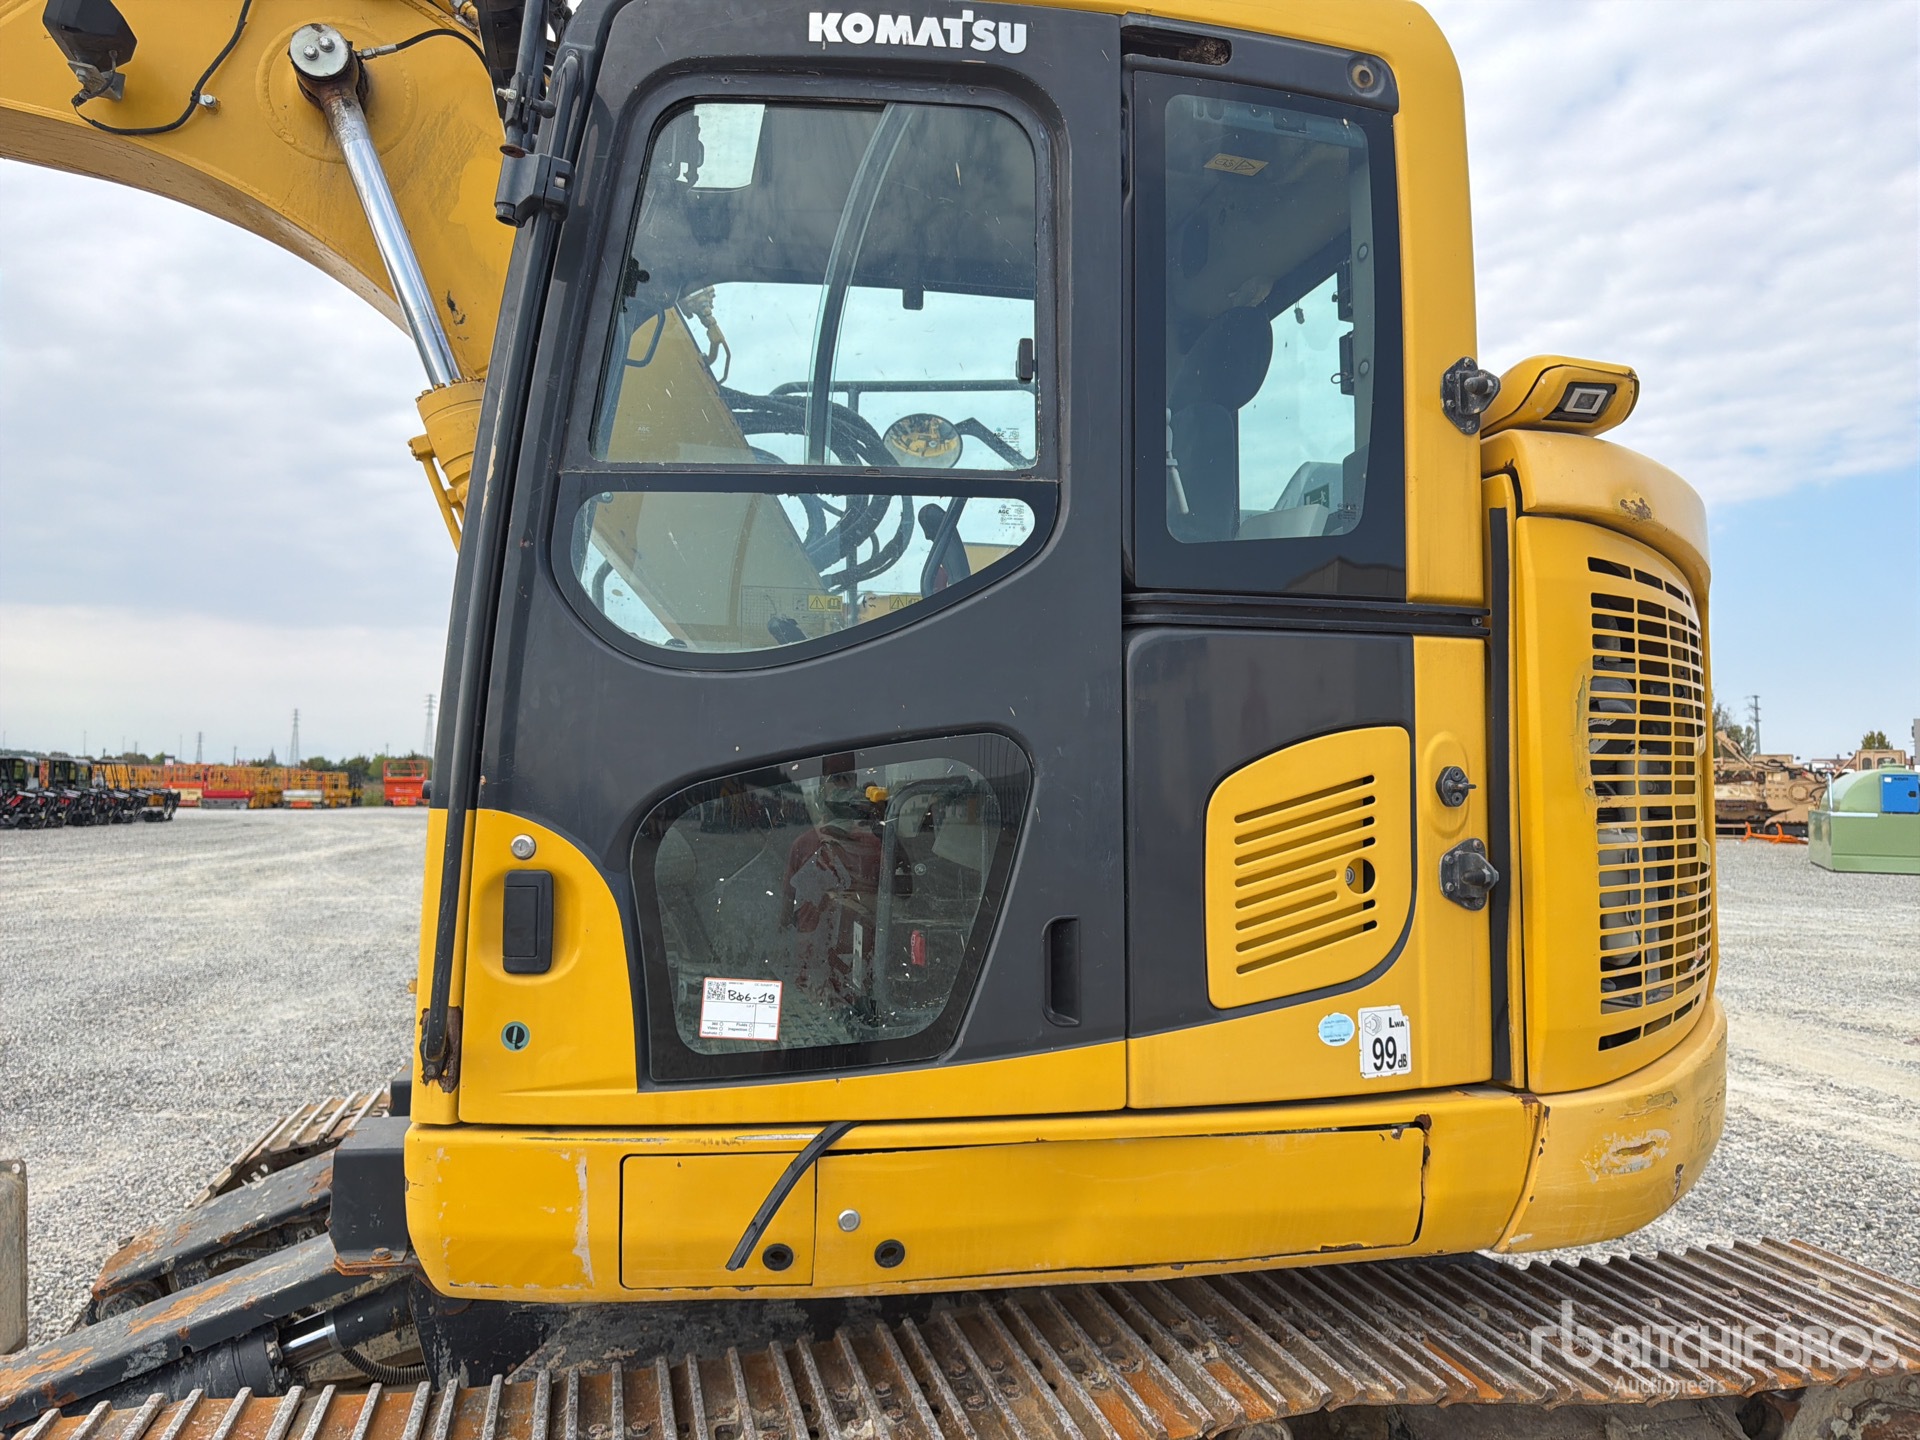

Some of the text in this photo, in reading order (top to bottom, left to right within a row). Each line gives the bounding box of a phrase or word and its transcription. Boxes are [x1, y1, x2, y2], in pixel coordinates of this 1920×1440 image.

[808, 9, 1027, 54] KOMATSU
[1372, 1035, 1408, 1072] 99 dB
